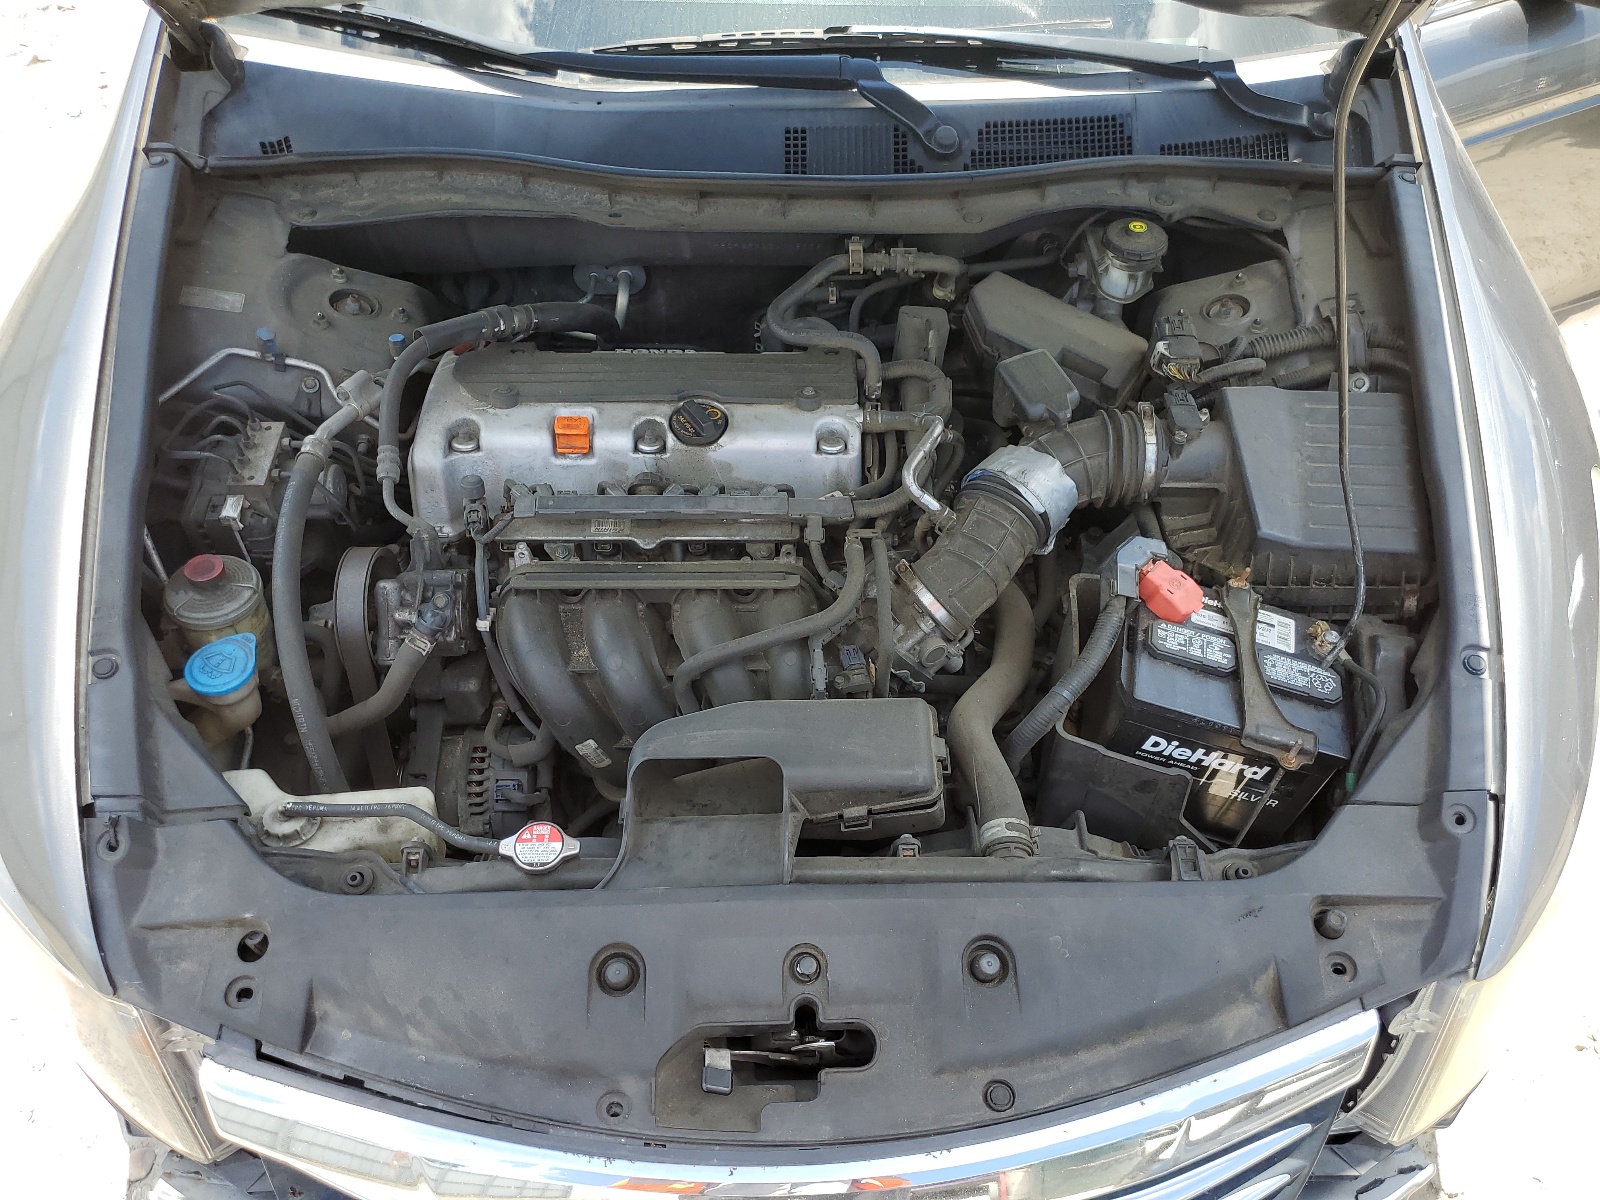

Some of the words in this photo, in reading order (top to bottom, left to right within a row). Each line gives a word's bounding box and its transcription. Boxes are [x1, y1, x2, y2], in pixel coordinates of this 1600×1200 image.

[1167, 624, 1195, 636] DANGER
[1201, 633, 1226, 645] POISON
[1135, 750, 1166, 763] POWER
[1168, 757, 1198, 771] AHEAD
[1141, 735, 1271, 781] DieHard
[1228, 790, 1279, 808] SILVR
